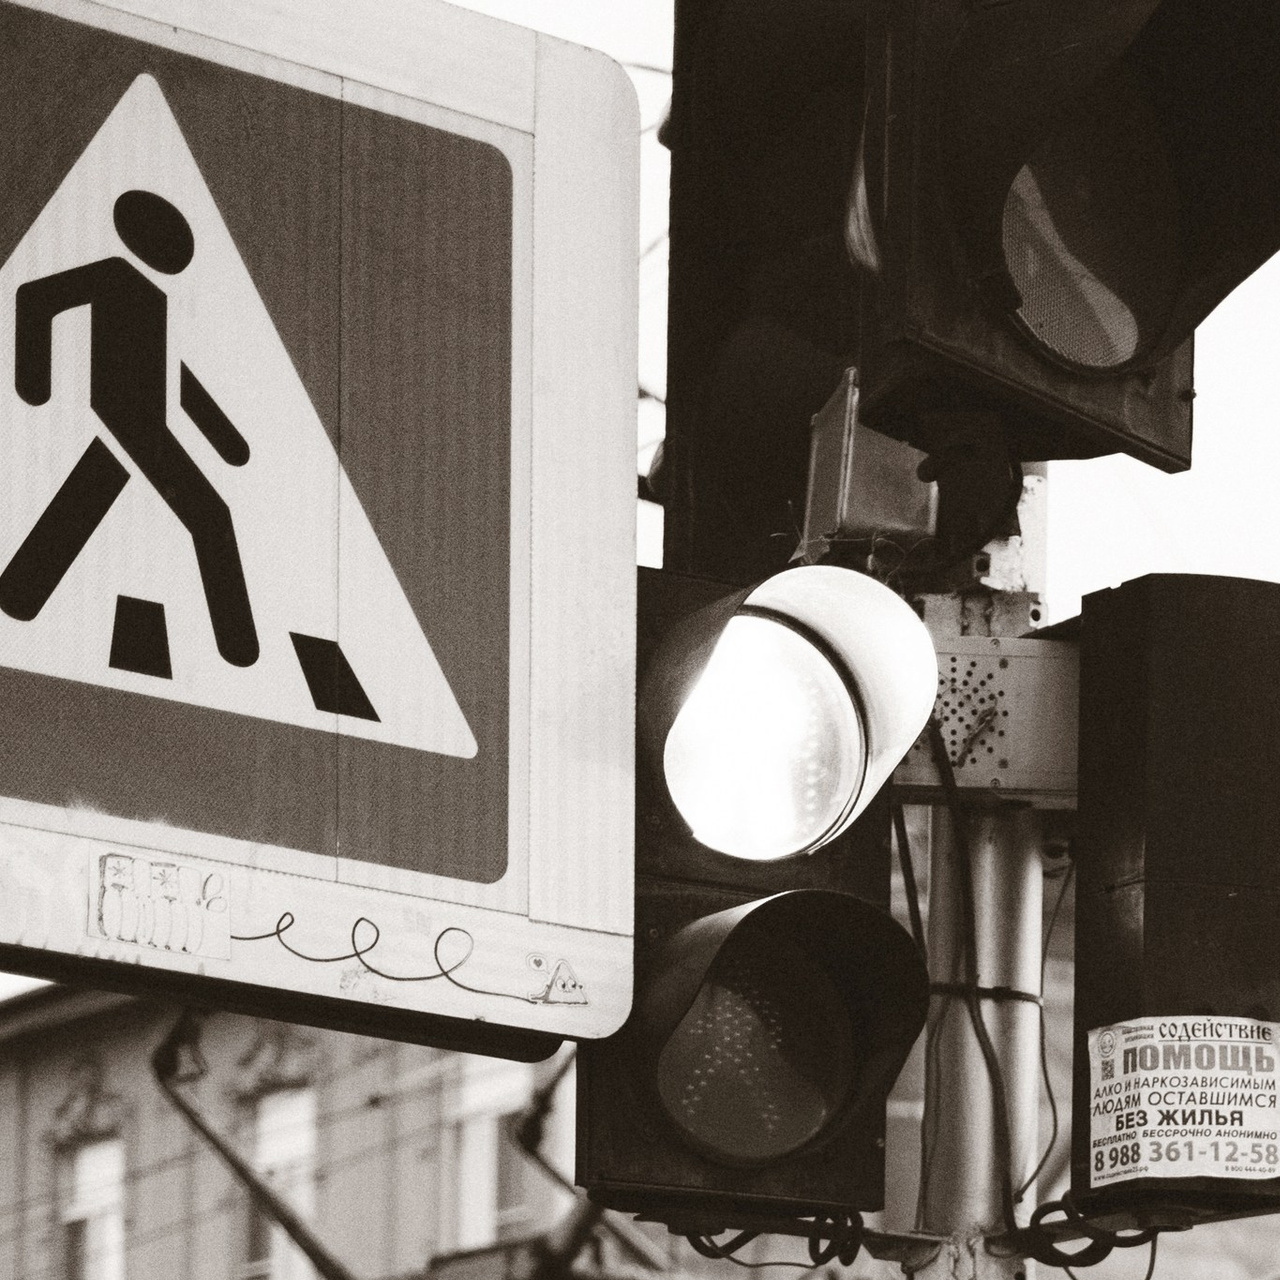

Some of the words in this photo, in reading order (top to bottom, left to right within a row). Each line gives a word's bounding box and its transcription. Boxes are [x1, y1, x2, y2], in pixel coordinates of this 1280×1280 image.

[1158, 1018, 1273, 1042] СОДЕЙСТВИЕ
[1123, 1044, 1275, 1076] ПОМОЩЬ
[1094, 1082, 1122, 1099] АЛКО
[1124, 1079, 1131, 1092] И
[1134, 1076, 1276, 1090] НАРКОЗАВИСИМЫМ
[1093, 1093, 1141, 1116] ЛЮДЯМ
[1148, 1091, 1277, 1108] ОСТАВШИМСЯ
[1116, 1110, 1148, 1131] БЕЗ
[1157, 1109, 1243, 1126] ЖИЛЬЯ
[1093, 1131, 1137, 1148] БЕСПЛАТНО
[1142, 1129, 1211, 1138] БЕССРОЧНО
[1215, 1130, 1277, 1140] АНОНИМНО
[1095, 1150, 1104, 1171] 8
[1109, 1142, 1141, 1169] 988
[1149, 1140, 1279, 1164] 361-12-58
